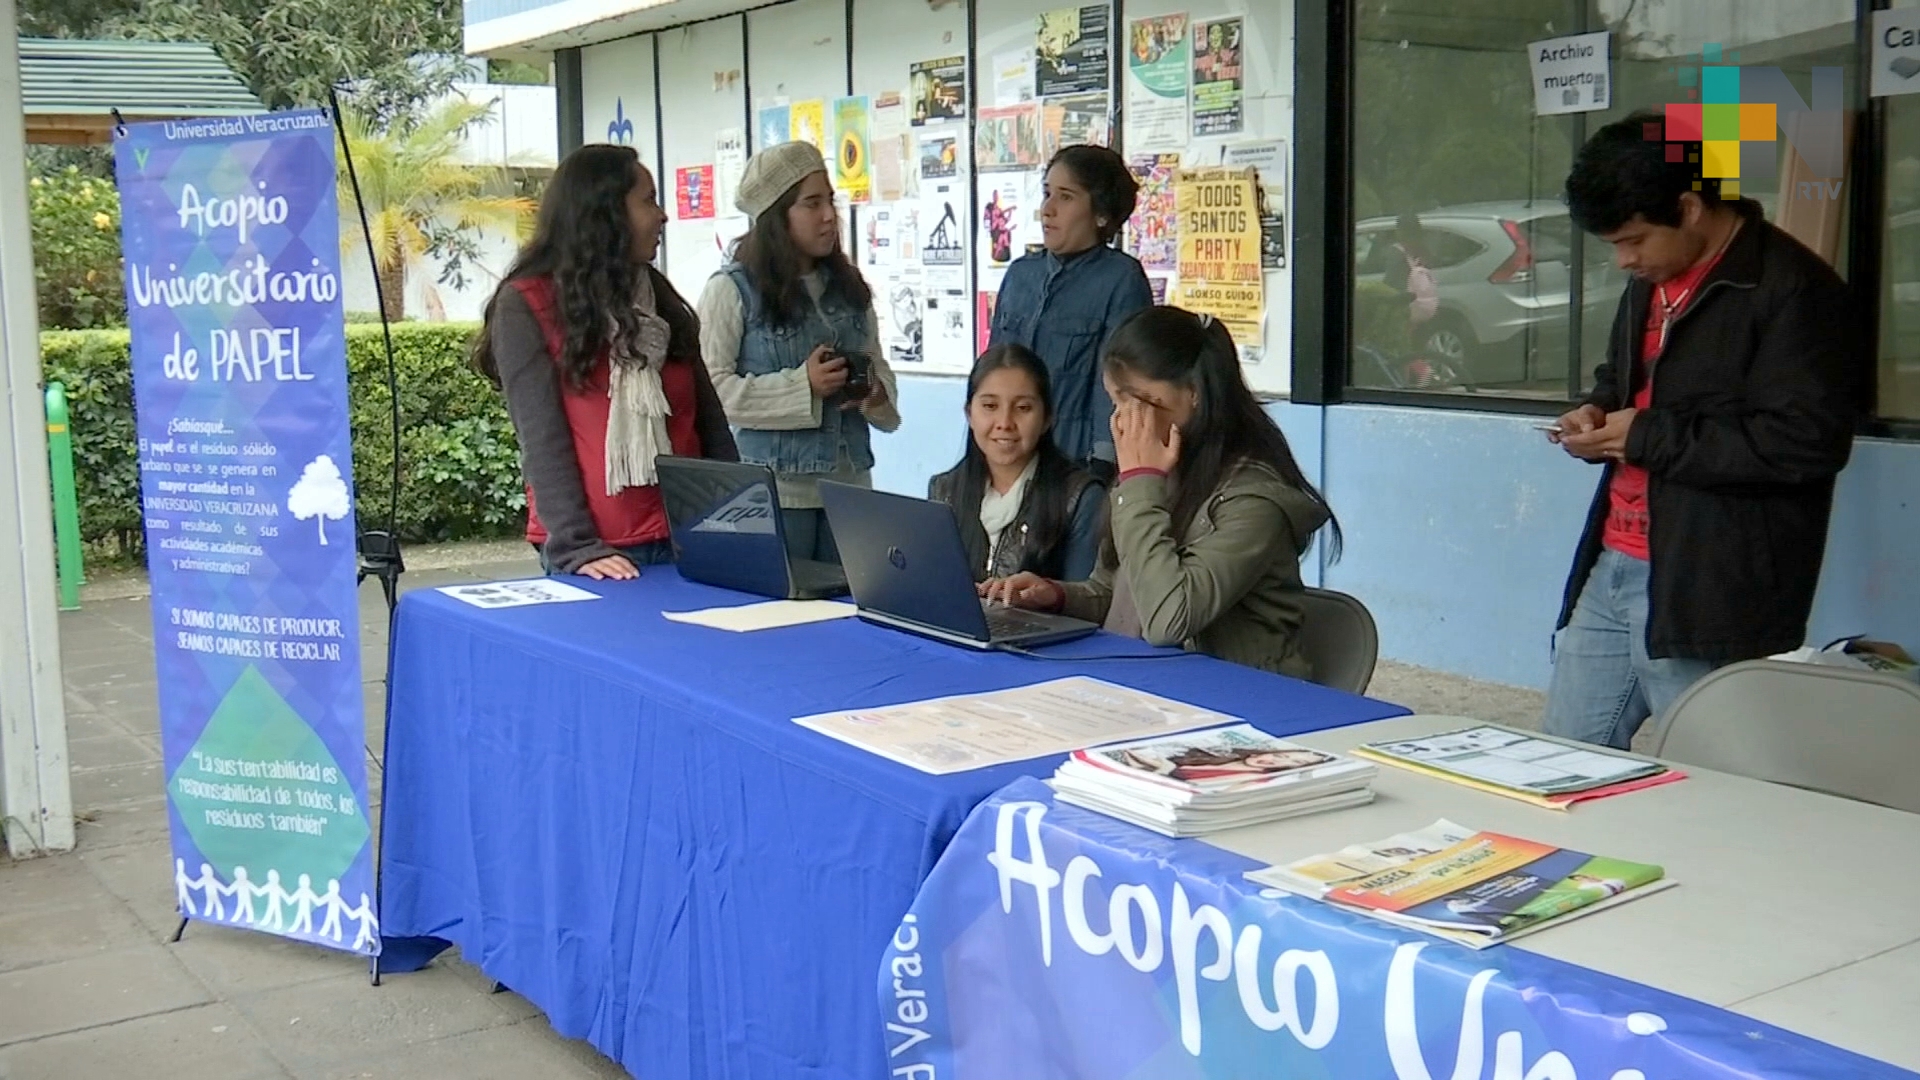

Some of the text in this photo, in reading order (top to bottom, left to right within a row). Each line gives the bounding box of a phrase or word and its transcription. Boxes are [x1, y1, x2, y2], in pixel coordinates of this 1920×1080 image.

[1884, 26, 1920, 49] Ca
[1539, 44, 1594, 63] Archivo
[1543, 72, 1593, 89] muerto
[164, 118, 244, 140] Universidad
[1197, 185, 1241, 208] TODOS
[177, 181, 288, 244] Acopio
[1190, 211, 1246, 233] SANTOS
[1195, 238, 1241, 260] PARTY
[132, 254, 337, 307] Universitario
[163, 327, 315, 382] de PAPEL
[150, 439, 174, 456] papel
[177, 443, 187, 453] es
[190, 440, 198, 454] el
[243, 442, 277, 456] sólido
[141, 459, 277, 478] urbano que se se genera en
[158, 481, 255, 496] mayor cantidad en la
[144, 497, 279, 516] UNIVERSIDAD VERACRUZANA
[146, 519, 279, 537] como resultado de sus
[160, 537, 209, 552] actividades
[172, 556, 251, 575] y administrativas?
[171, 608, 345, 639] SI SOMOS CAPACES DE PRODUCIR,
[177, 632, 341, 662] SEAMOS CAPACES DE RECICLAR
[215, 754, 320, 783] sustentabilidad
[323, 767, 338, 785] es
[179, 777, 355, 816] responsabilidad de todos, los
[206, 808, 265, 829] residuos
[987, 802, 1340, 1057] Acopio
